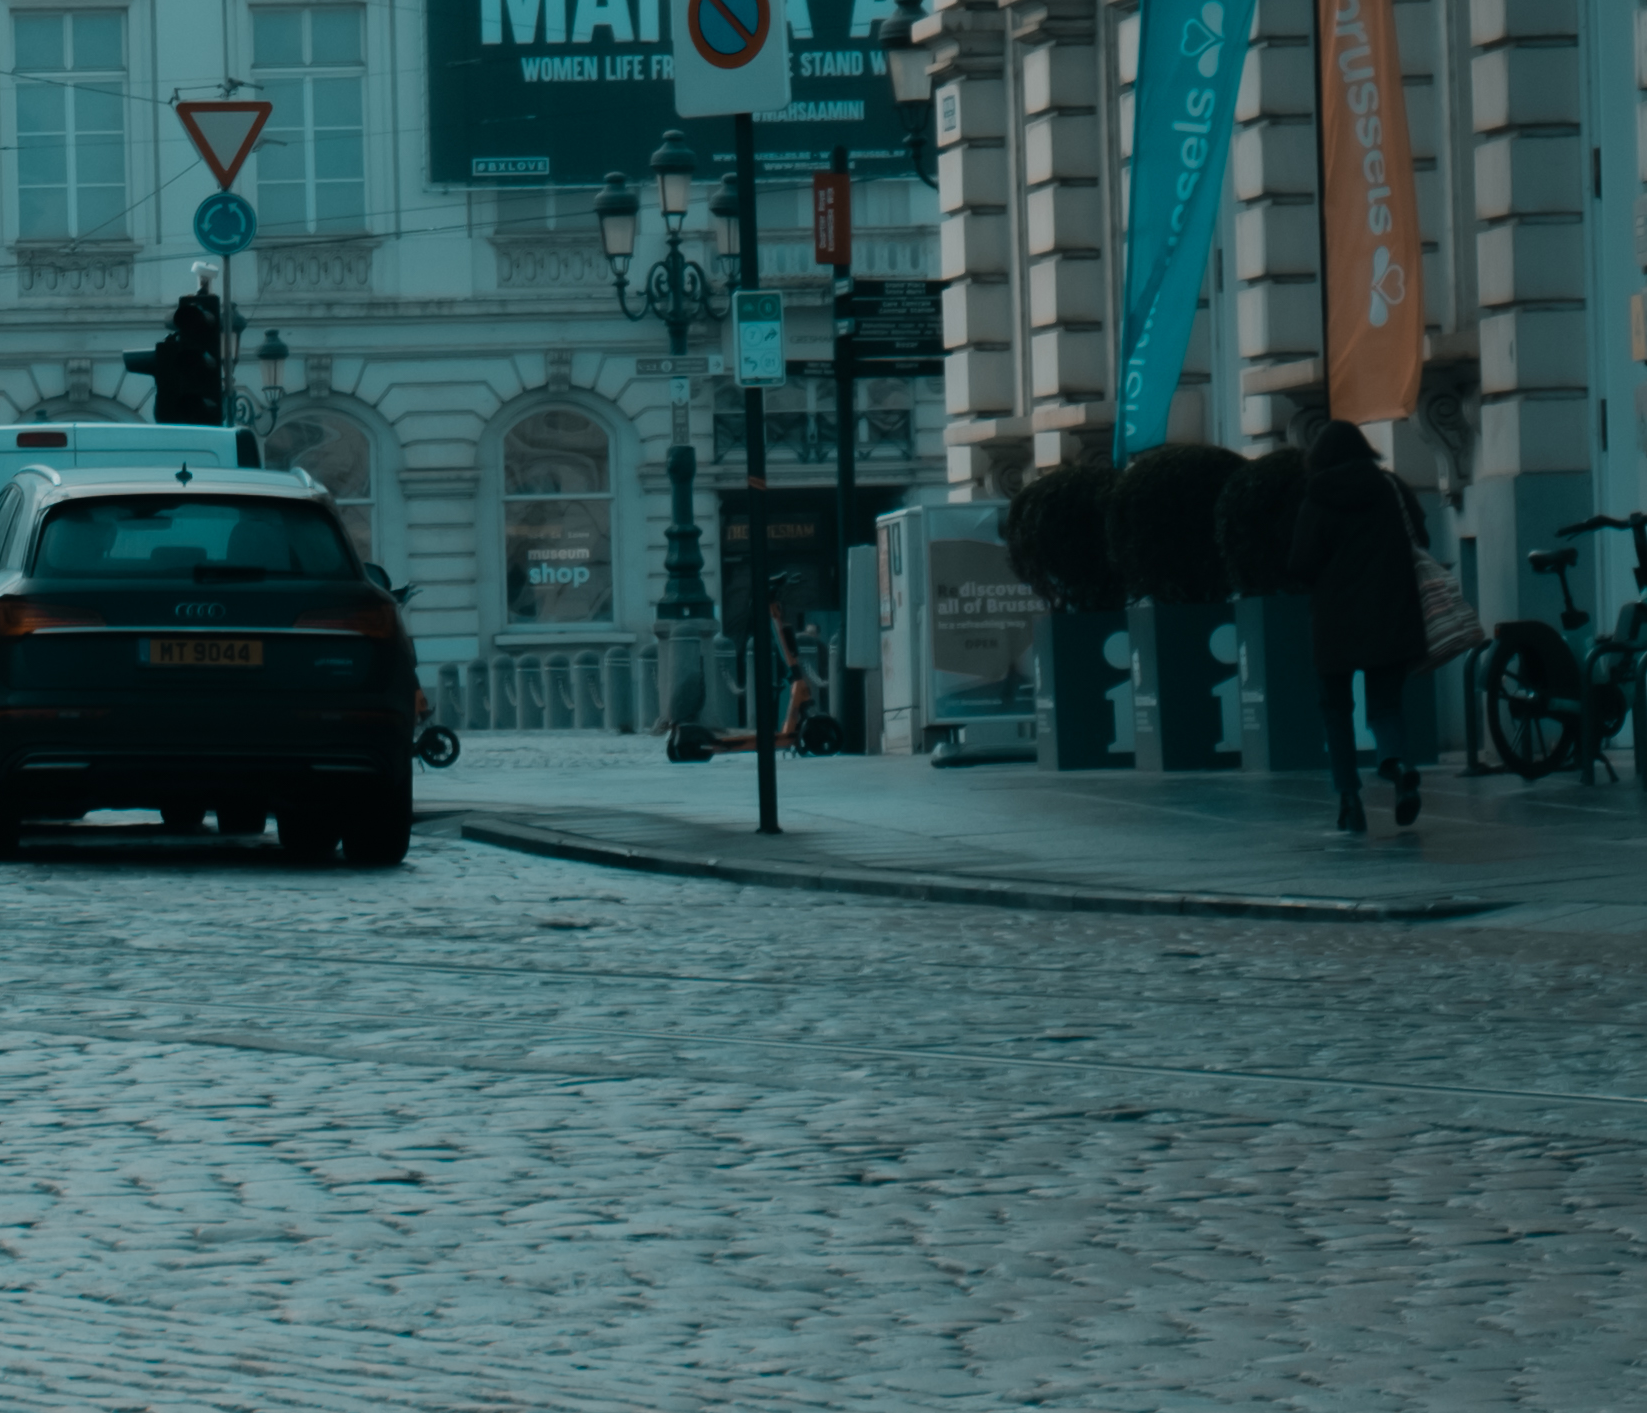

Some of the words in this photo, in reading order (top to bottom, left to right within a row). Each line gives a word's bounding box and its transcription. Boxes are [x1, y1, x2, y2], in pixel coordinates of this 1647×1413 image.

[522, 56, 598, 82] WOMEN
[605, 55, 644, 81] LIFE
[800, 52, 864, 77] STAND
[528, 548, 590, 560] museum
[529, 562, 590, 588] shop
[938, 599, 959, 615] all
[963, 598, 982, 614] of
[160, 642, 187, 662] MT
[194, 642, 250, 662] 9044
